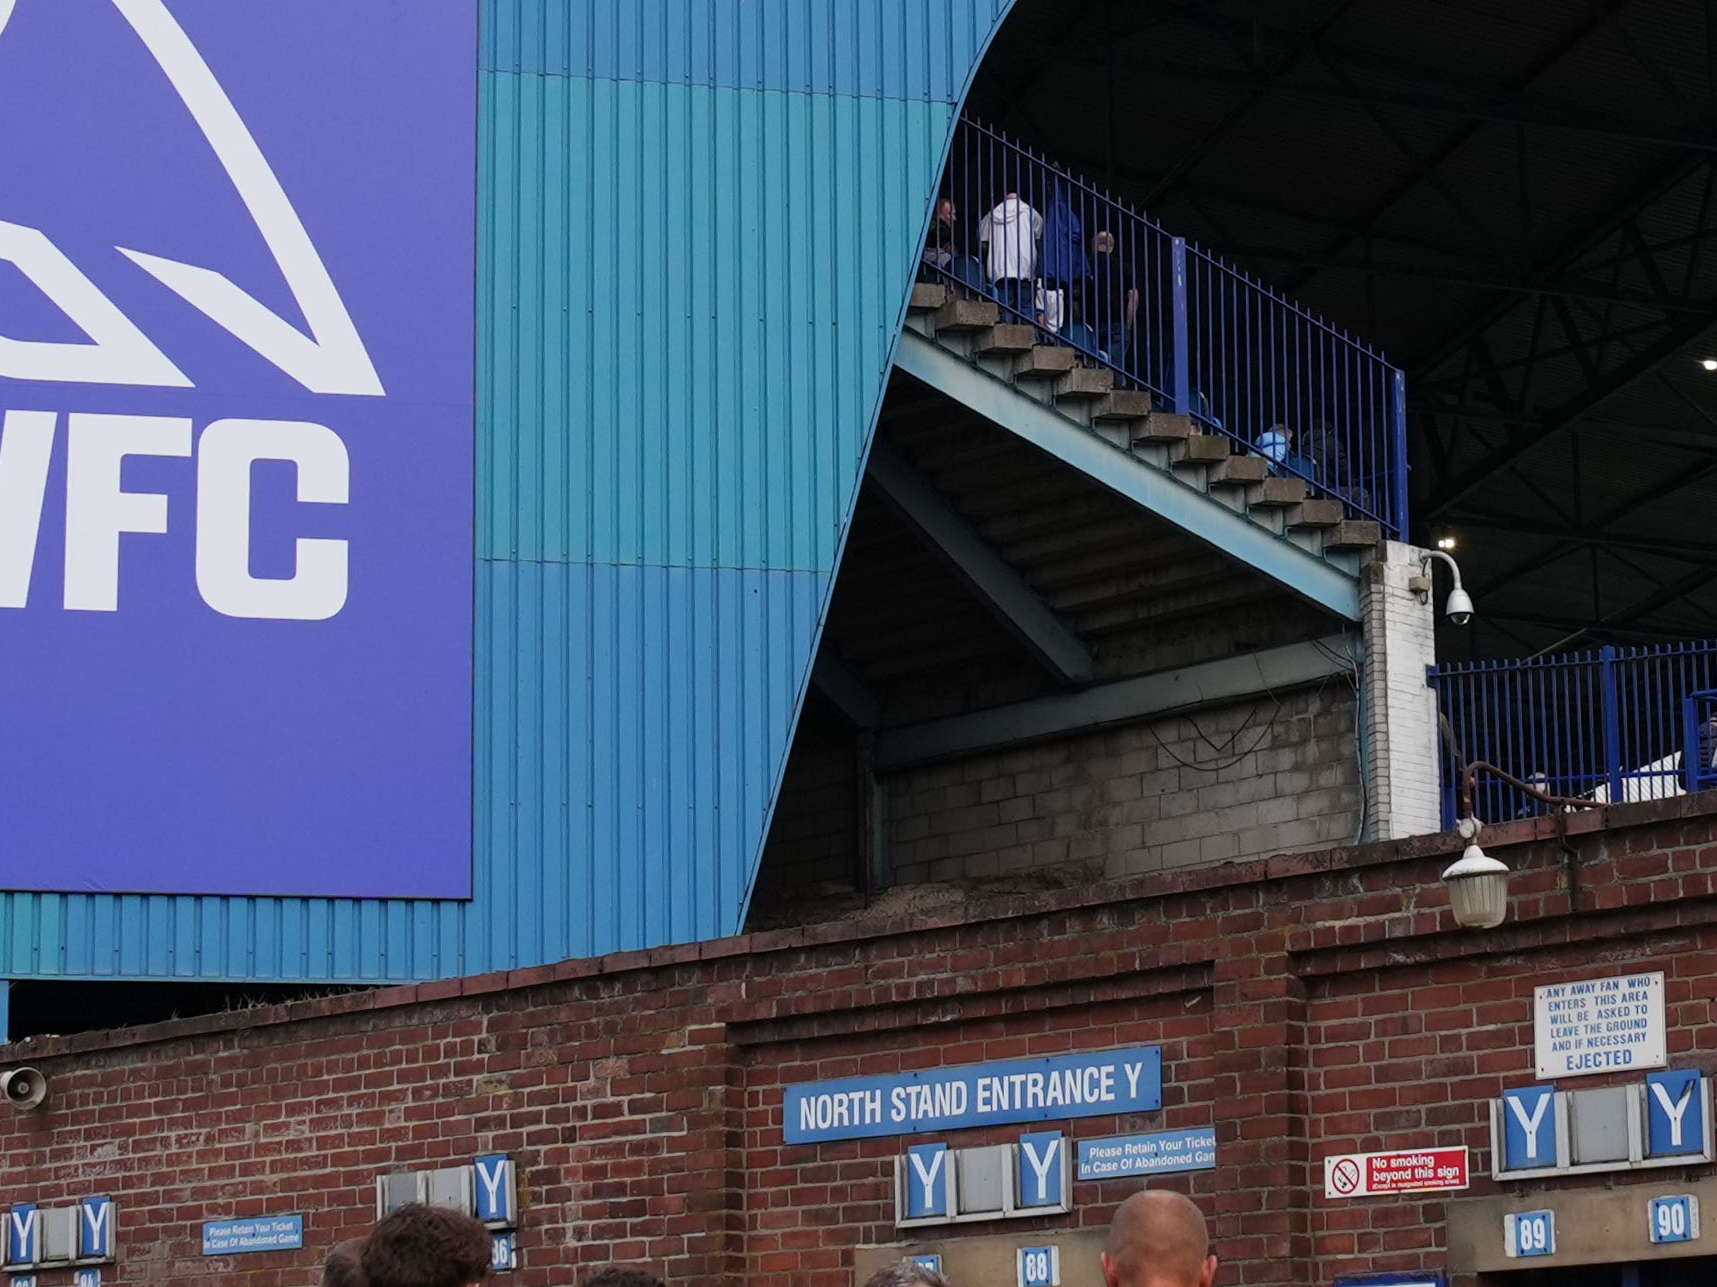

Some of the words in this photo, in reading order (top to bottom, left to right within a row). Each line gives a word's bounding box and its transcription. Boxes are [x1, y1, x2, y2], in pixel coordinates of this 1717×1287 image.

[1546, 987, 1566, 999] ANY
[1570, 983, 1596, 996] AWAY
[1600, 980, 1619, 992] FAN
[1627, 976, 1651, 989] WHO
[1548, 998, 1586, 1012] ENTERS
[1594, 994, 1617, 1006] THIS
[1621, 991, 1648, 1003] AREA
[1550, 1013, 1573, 1025] WILL
[1577, 1011, 1589, 1022] BE
[1597, 1006, 1630, 1020] ASKED
[1634, 1004, 1648, 1015] TO
[1550, 1025, 1580, 1039] LEAVE
[1584, 1023, 1602, 1035] THE
[1606, 1018, 1647, 1032] GROUND
[1551, 1041, 1571, 1052] AND
[1575, 1039, 1583, 1050] IF
[1587, 1032, 1647, 1048] NECESSARY
[1566, 1049, 1632, 1071] EJECTED
[799, 1089, 882, 1130] NORTH
[890, 1080, 967, 1121] STAND
[976, 1065, 1115, 1112] ENTRANCE
[1123, 1062, 1143, 1099] Y
[1650, 1080, 1696, 1146] Y
[1507, 1093, 1551, 1158] Y
[1089, 1146, 1122, 1159] Please
[1125, 1142, 1156, 1155] Retain
[1159, 1139, 1182, 1151] Your
[1185, 1135, 1216, 1149] Ticket
[1022, 1140, 1059, 1199] Y
[1081, 1163, 1090, 1174] In
[1093, 1161, 1118, 1173] Case
[1121, 1159, 1132, 1170] Of
[1135, 1154, 1192, 1169] Abandoned
[1372, 1157, 1387, 1169] No
[1390, 1154, 1435, 1168] smoking
[476, 1159, 505, 1213] Y
[910, 1150, 944, 1209] Y
[1373, 1169, 1411, 1183] beyond
[1415, 1168, 1434, 1179] this
[1437, 1166, 1460, 1179] sign
[84, 1201, 110, 1250] Y
[209, 1228, 231, 1237] Please
[255, 1223, 271, 1232] Your
[272, 1221, 293, 1231] Ticket
[1658, 1203, 1684, 1236] 90
[12, 1210, 34, 1258] Y
[212, 1239, 228, 1249] Case
[239, 1234, 277, 1246] Abandoned
[278, 1233, 299, 1243] Game
[1520, 1218, 1546, 1250] 89
[1026, 1252, 1048, 1282] 88
